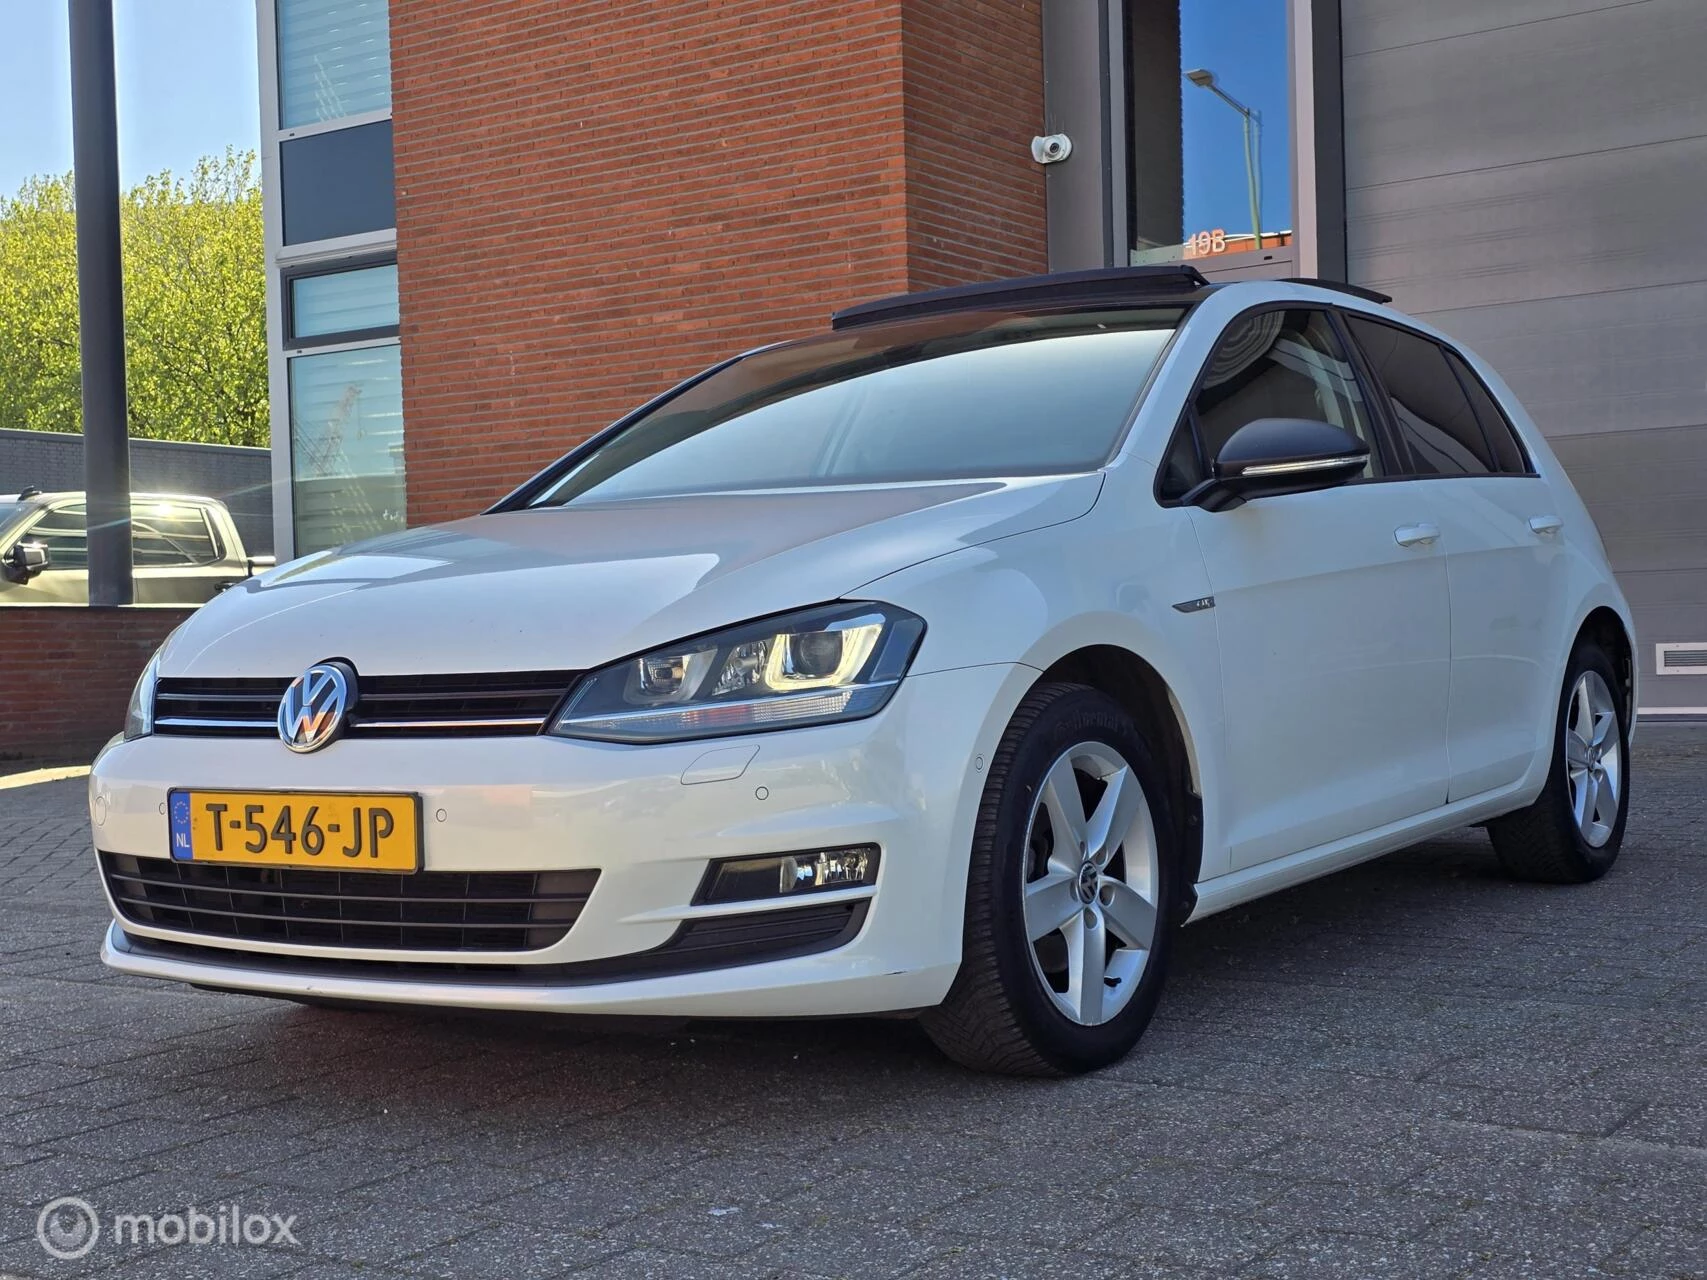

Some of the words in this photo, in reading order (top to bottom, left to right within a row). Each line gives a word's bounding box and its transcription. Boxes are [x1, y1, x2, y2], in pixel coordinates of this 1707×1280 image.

[1188, 228, 1226, 256] 19B
[176, 832, 191, 849] NL
[206, 803, 395, 859] T-546-JP
